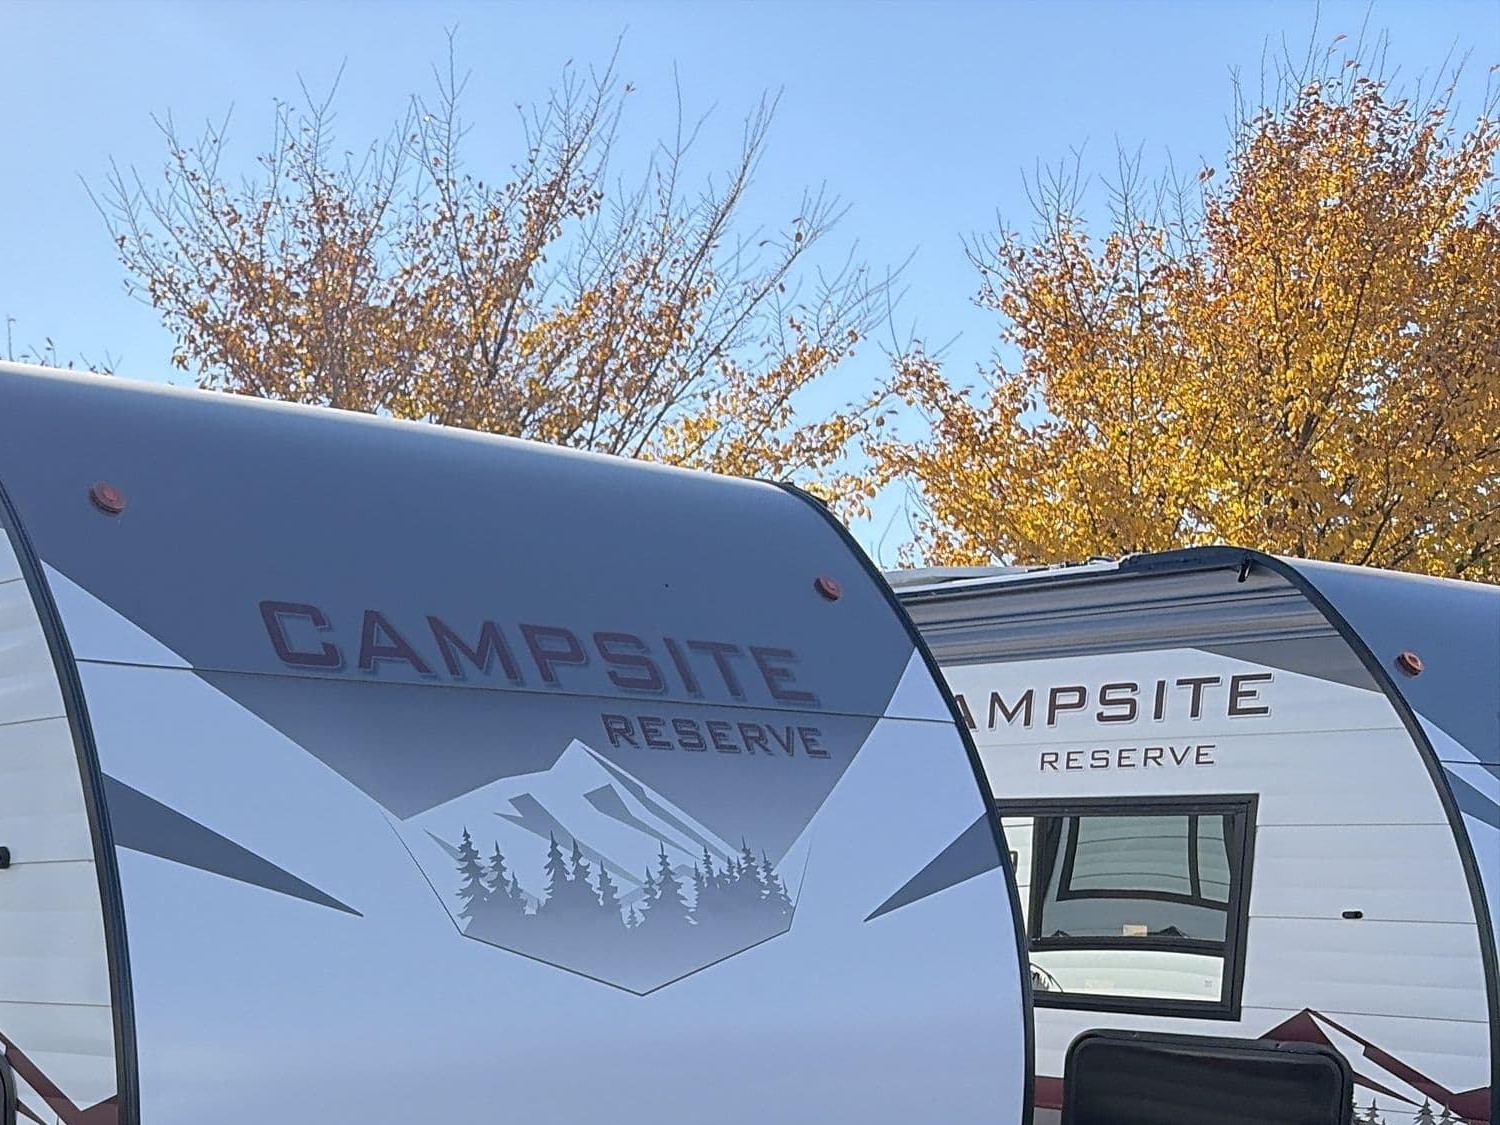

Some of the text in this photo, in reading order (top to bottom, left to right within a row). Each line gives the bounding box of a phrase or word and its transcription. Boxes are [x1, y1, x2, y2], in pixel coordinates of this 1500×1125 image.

[258, 600, 818, 705] CAMPSITE
[601, 713, 830, 759] RESERVE
[1040, 744, 1218, 771] RESERVE
